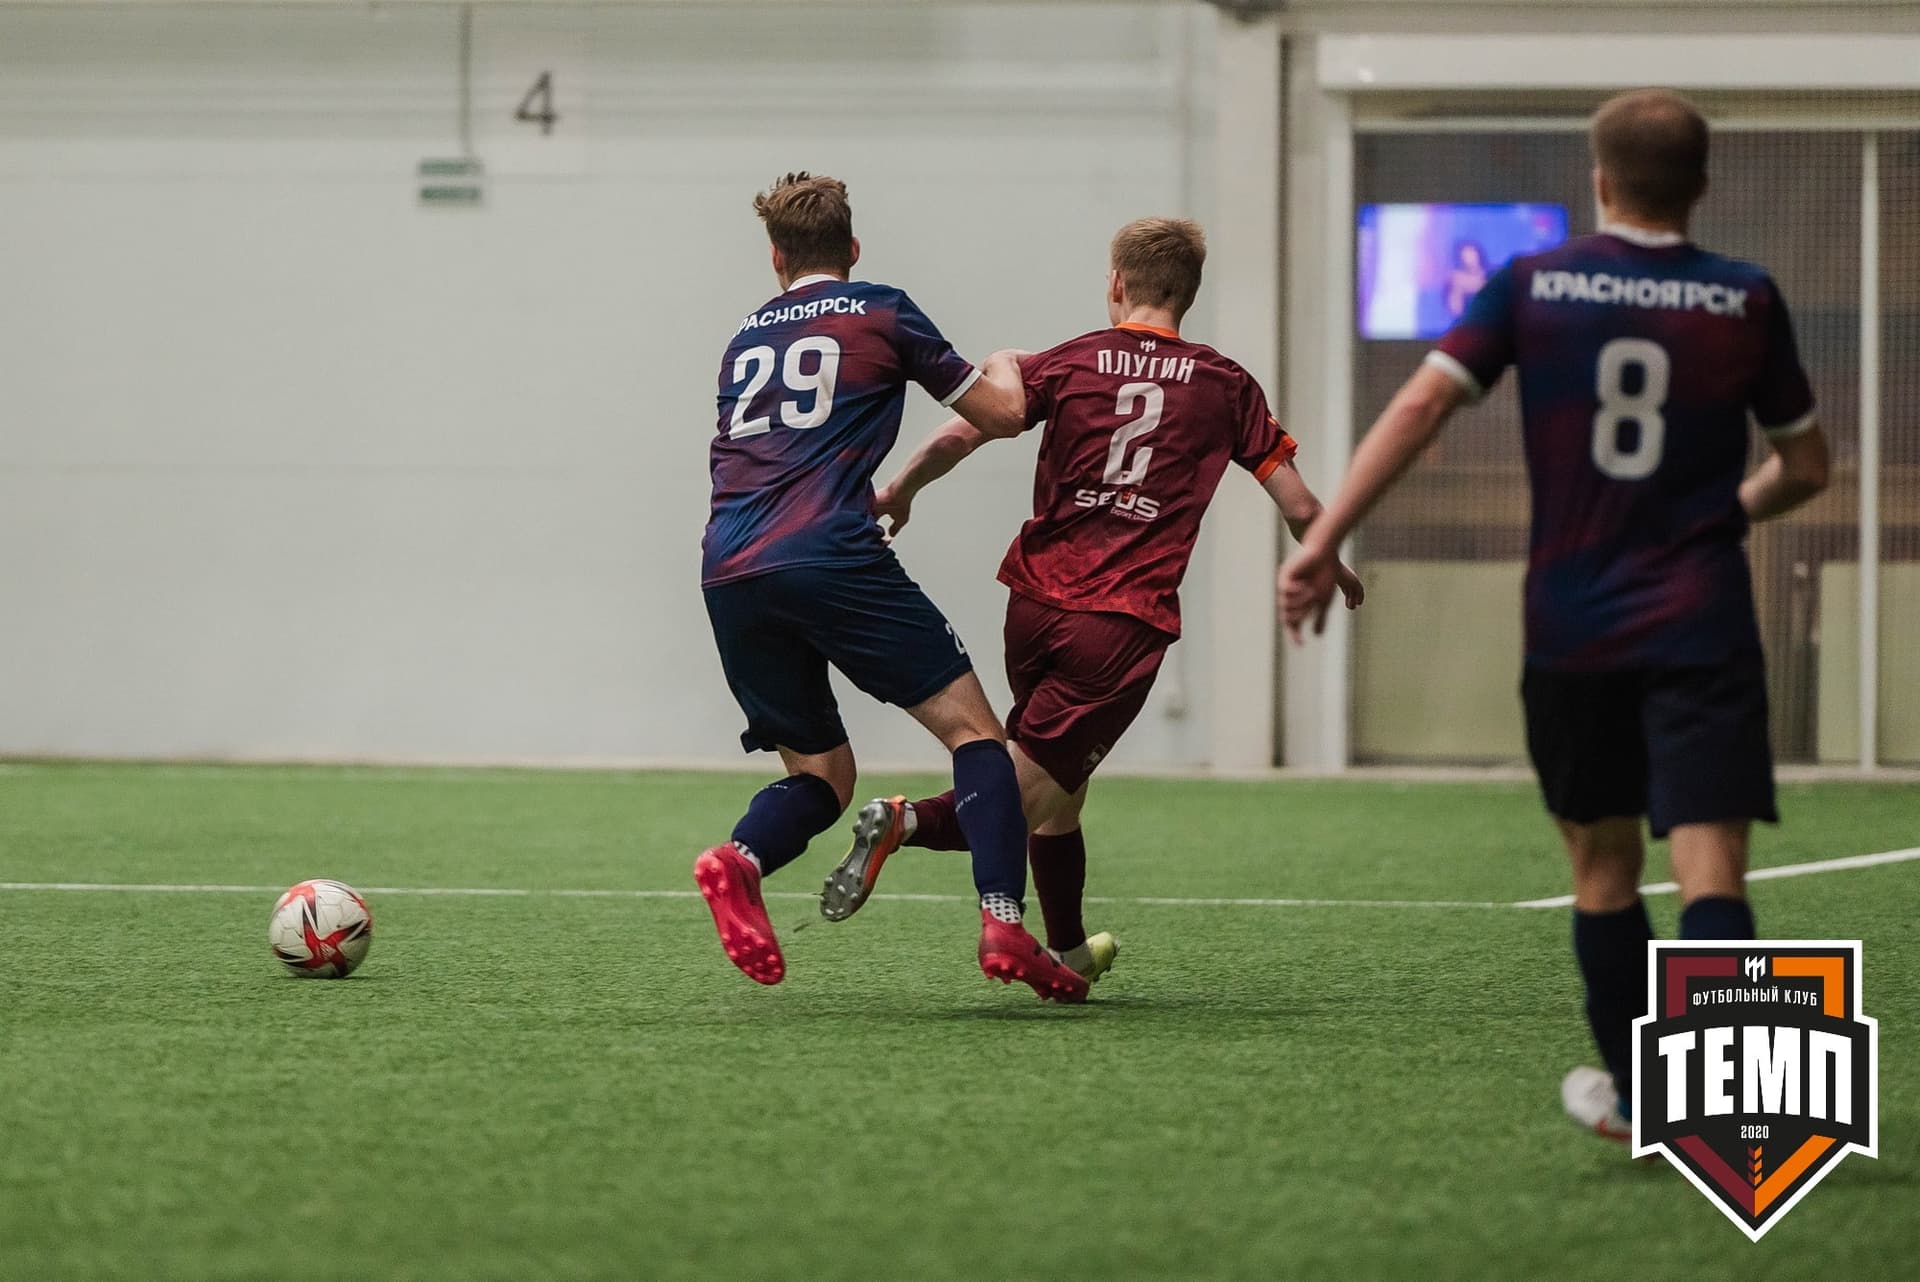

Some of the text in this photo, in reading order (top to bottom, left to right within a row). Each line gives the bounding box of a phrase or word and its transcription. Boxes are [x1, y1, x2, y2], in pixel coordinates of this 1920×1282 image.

[512, 70, 559, 137] 4
[732, 296, 867, 337] РАСНОЯРСК
[1531, 270, 1747, 318] КРАСНОЯРСК
[728, 335, 841, 440] 29
[1097, 349, 1196, 384] ПЛУГИН
[1102, 382, 1165, 486] 2
[1591, 337, 1671, 481] 8
